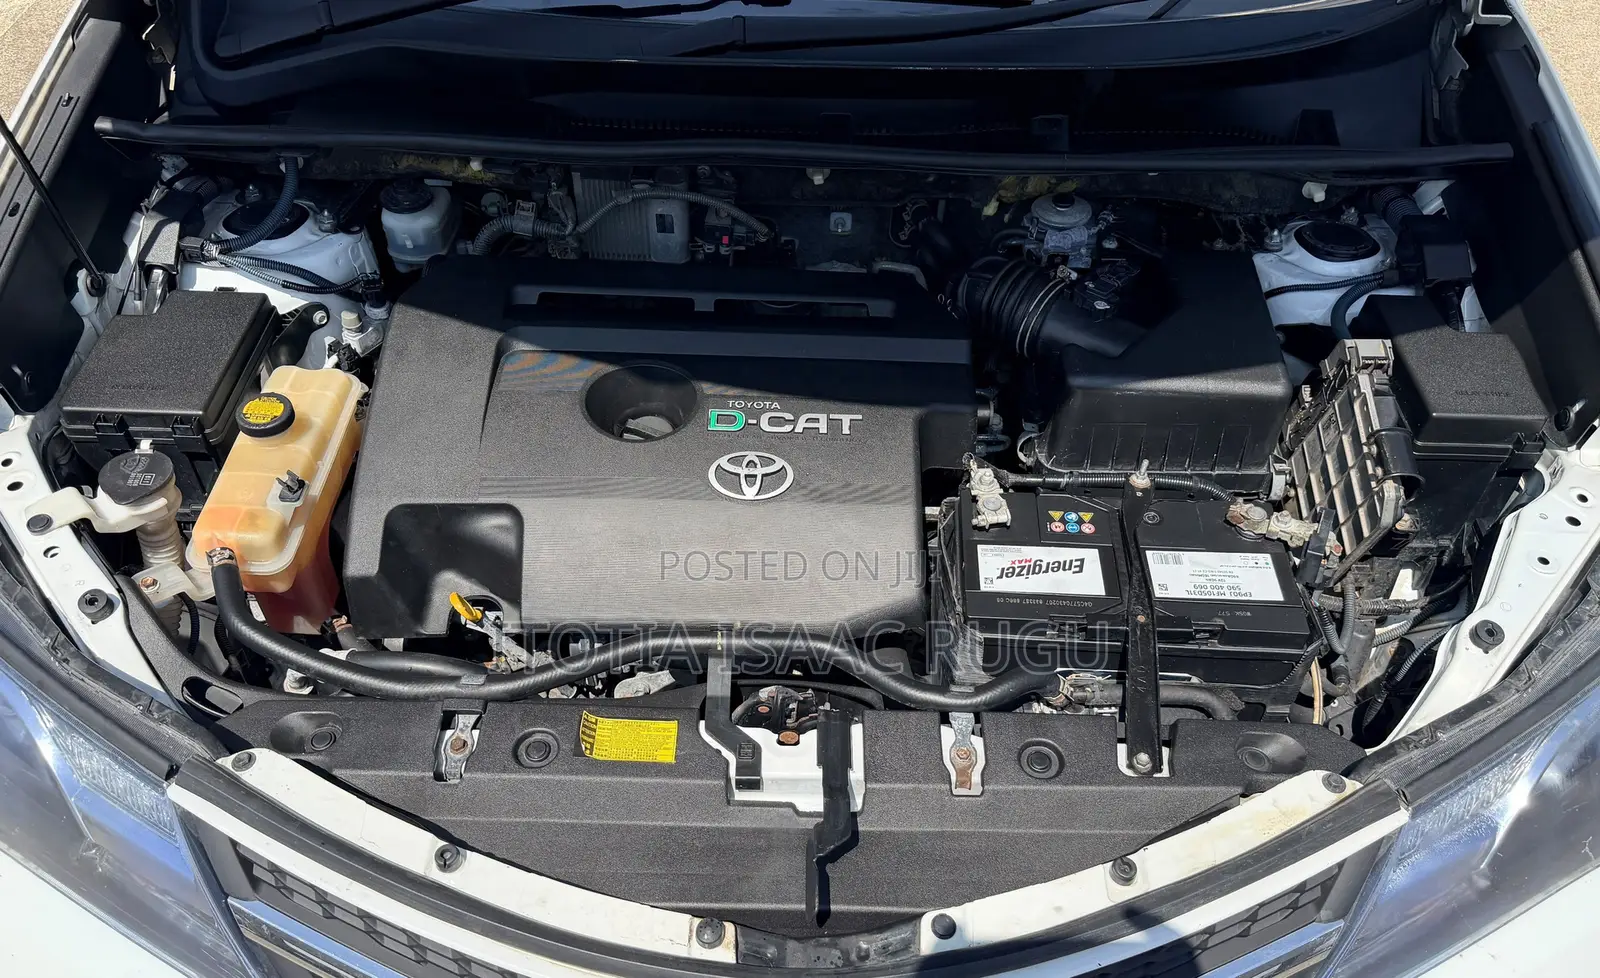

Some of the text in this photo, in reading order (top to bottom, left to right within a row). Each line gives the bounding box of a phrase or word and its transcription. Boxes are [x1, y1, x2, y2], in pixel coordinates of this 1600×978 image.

[727, 400, 781, 410] TOYOTA
[707, 409, 863, 436] D-CAT
[996, 558, 1086, 580] Energizer
[1010, 557, 1033, 566] MAX
